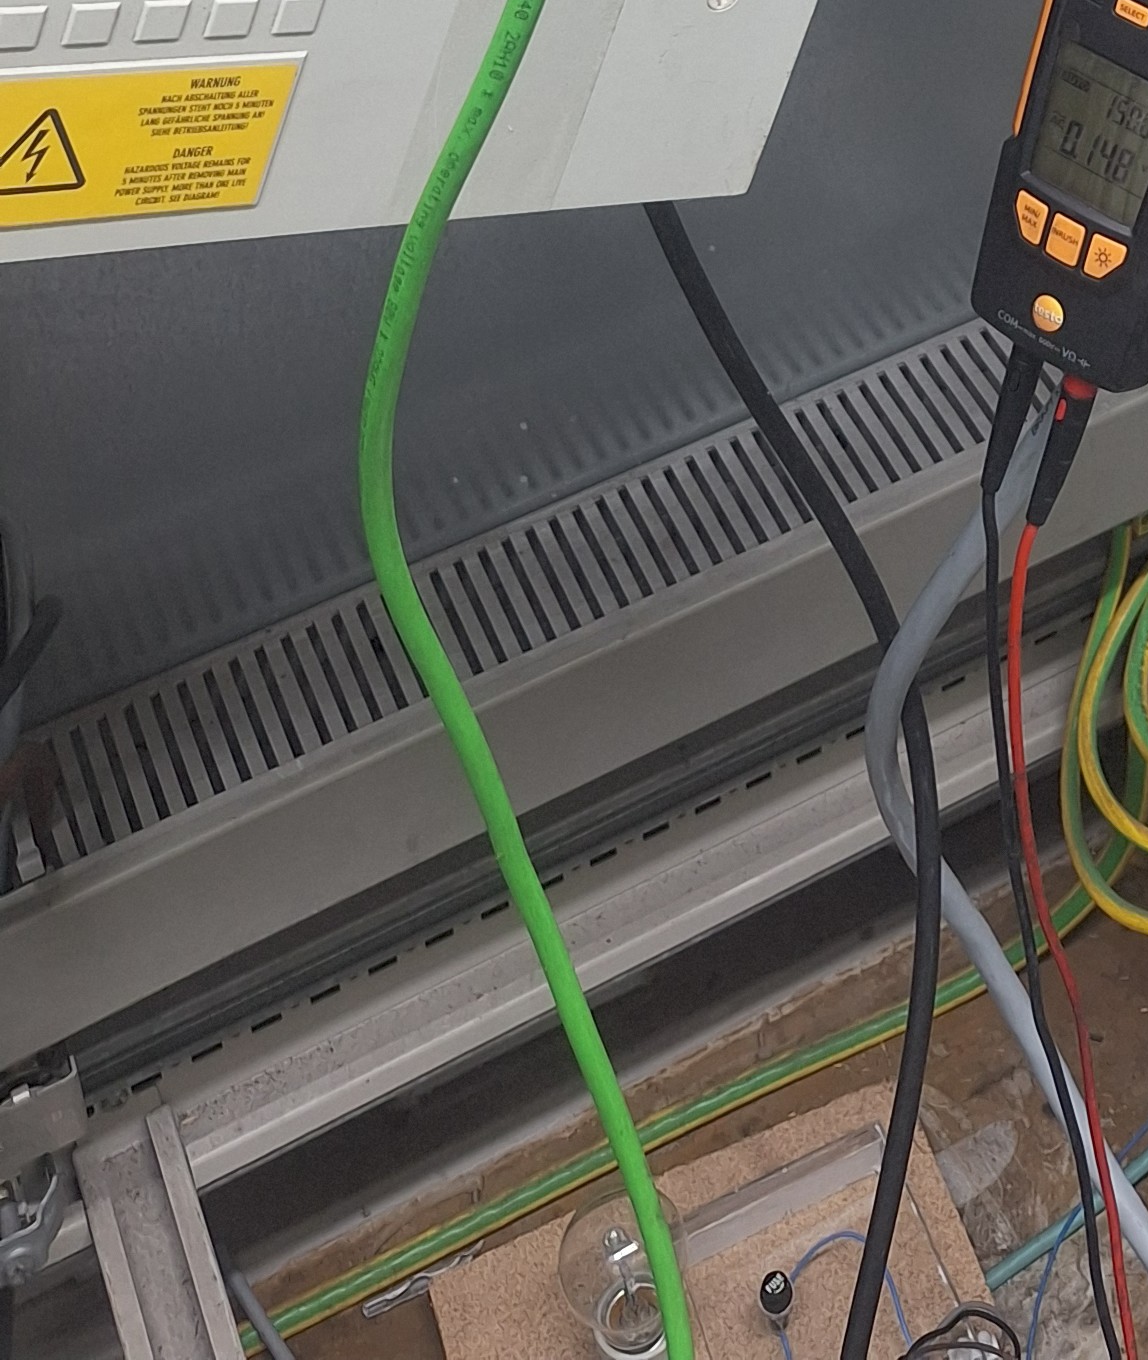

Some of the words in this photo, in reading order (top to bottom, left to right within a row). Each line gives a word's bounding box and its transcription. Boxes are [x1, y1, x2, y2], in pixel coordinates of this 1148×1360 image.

[1119, 3, 1146, 22] SELECT
[190, 75, 242, 90] WARNUNG
[238, 89, 260, 98] ALLER
[172, 145, 214, 159] DANGER
[124, 163, 169, 175] HAZARDOUS
[171, 160, 202, 171] VOLTAGE
[203, 158, 235, 168] REMAINS
[128, 174, 162, 185] MINUTES
[164, 172, 186, 182] AFTER
[187, 169, 226, 180] REMOVING
[227, 168, 247, 177] MAIN
[114, 187, 141, 197] POWER
[195, 180, 214, 190] THAN
[1022, 215, 1038, 229] MAX
[997, 309, 1019, 329] COM
[1033, 302, 1063, 325] testo
